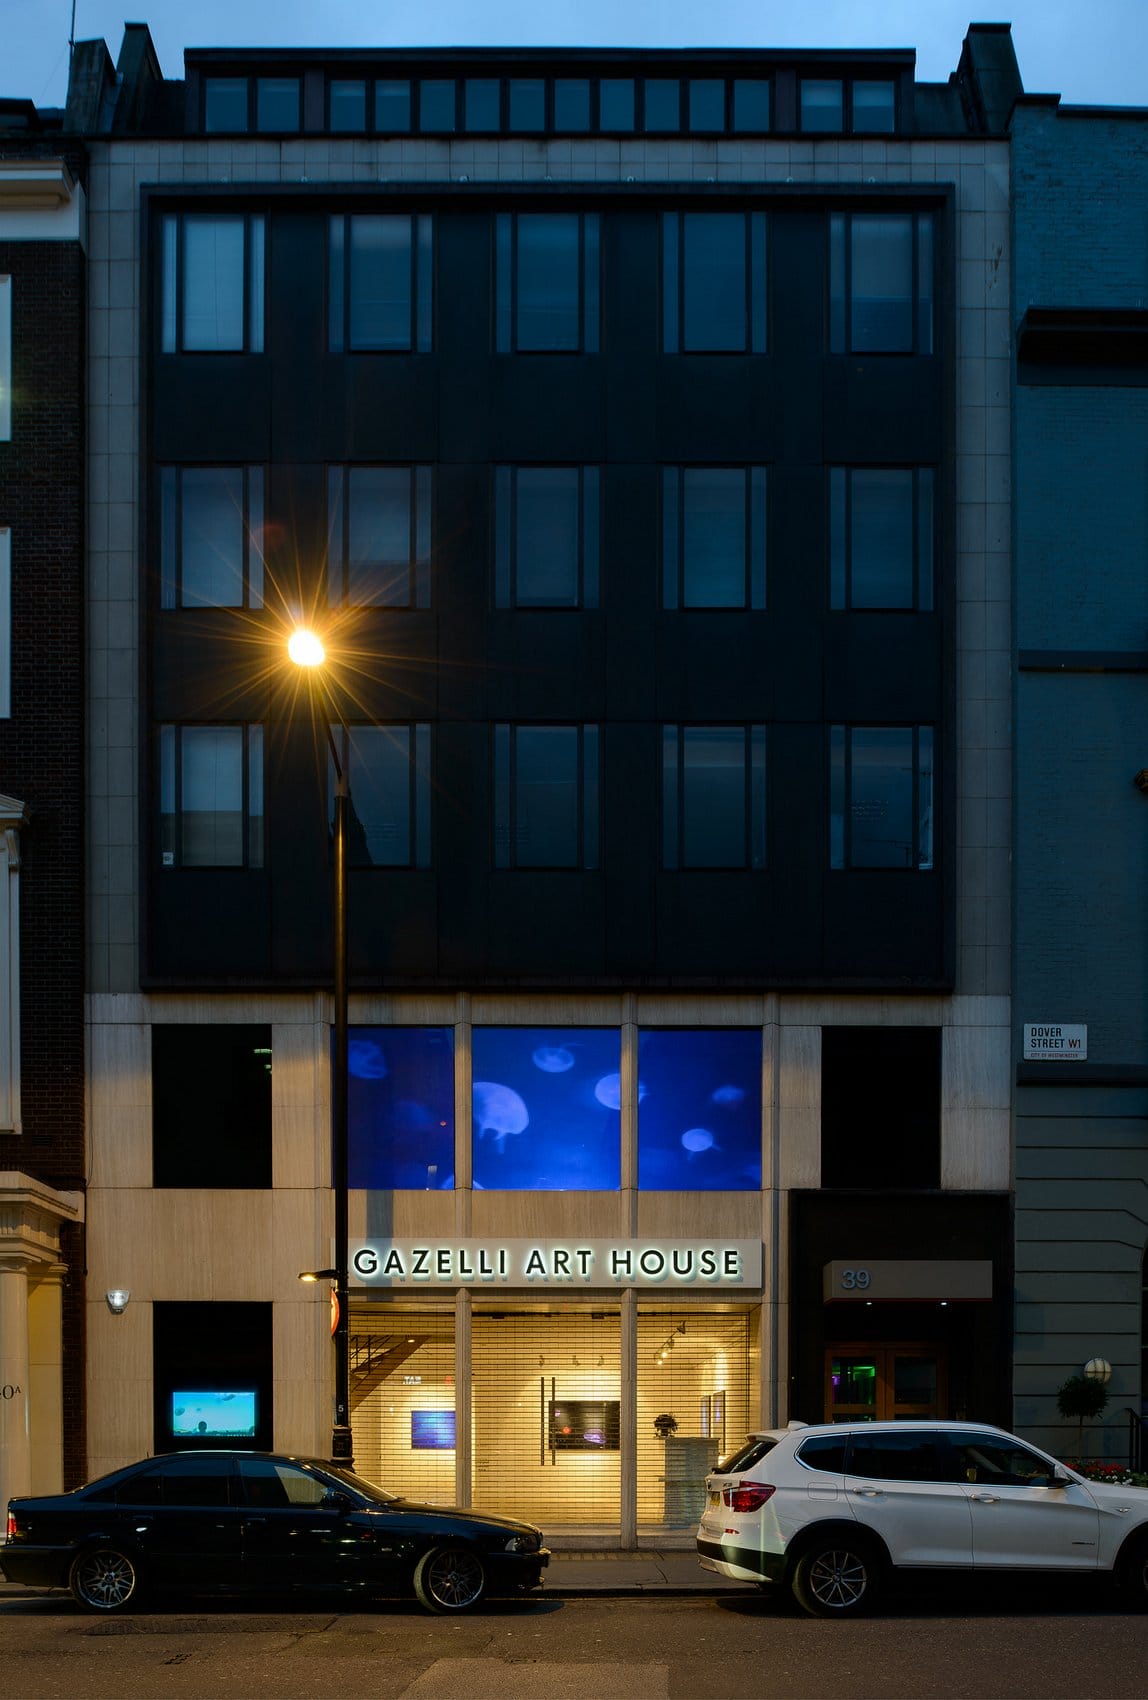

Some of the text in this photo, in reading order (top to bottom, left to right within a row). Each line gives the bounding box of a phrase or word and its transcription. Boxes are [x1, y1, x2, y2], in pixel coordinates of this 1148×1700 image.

[1031, 1027, 1062, 1037] DOVER
[1031, 1038, 1081, 1048] STREET W1
[353, 1249, 739, 1275] GAZELLI ART HOUSE
[842, 1270, 870, 1289] 39
